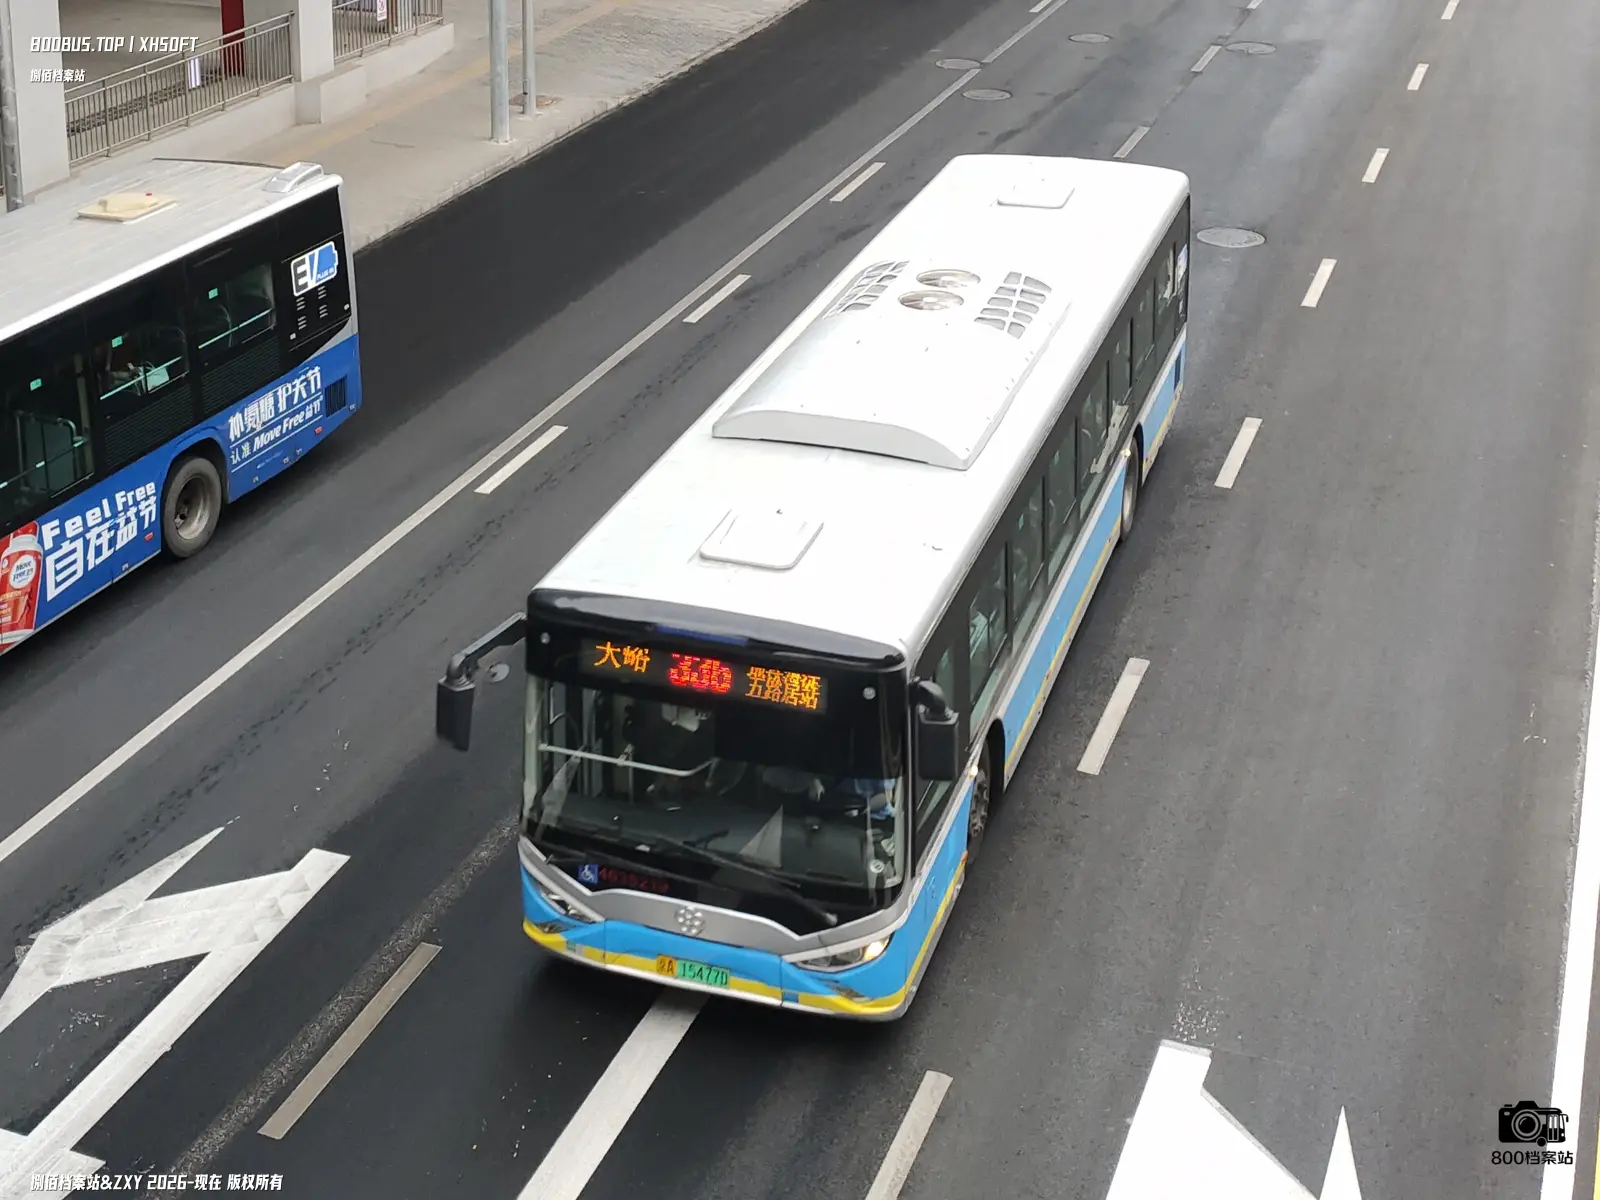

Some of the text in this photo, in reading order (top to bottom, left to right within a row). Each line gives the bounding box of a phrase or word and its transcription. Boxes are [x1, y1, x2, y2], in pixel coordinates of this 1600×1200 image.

[230, 442, 251, 465] 认准
[253, 425, 282, 452] Move
[282, 409, 305, 434] Free
[41, 481, 157, 551] Feel Free
[45, 496, 157, 602] 自在益节
